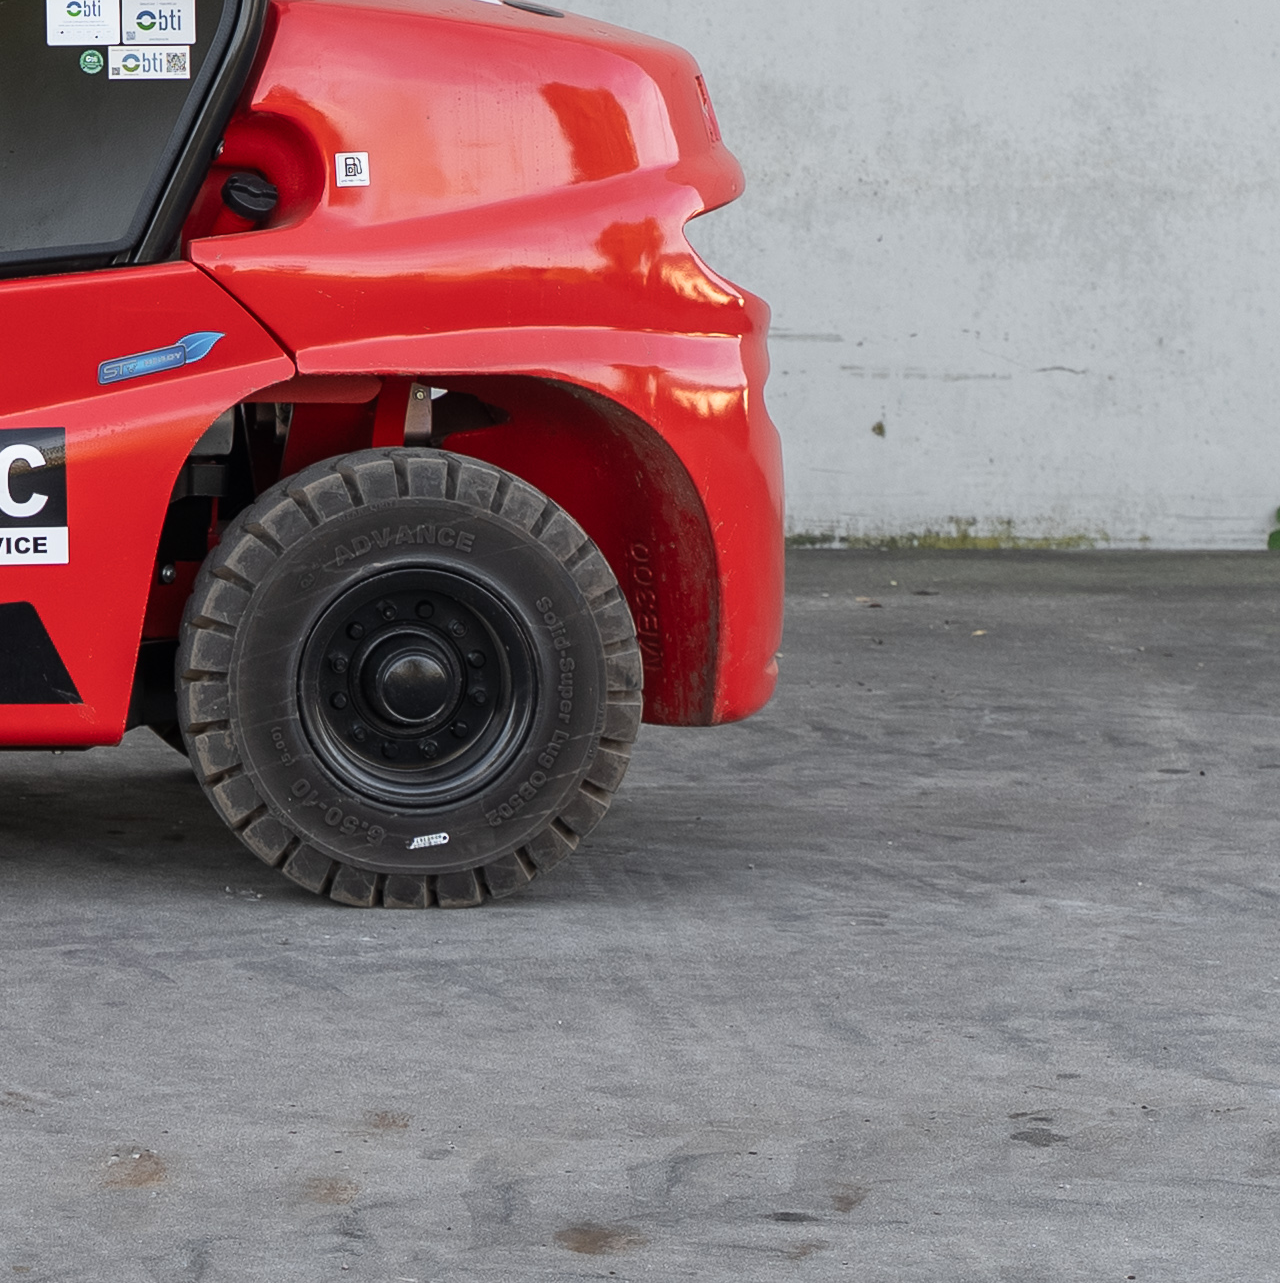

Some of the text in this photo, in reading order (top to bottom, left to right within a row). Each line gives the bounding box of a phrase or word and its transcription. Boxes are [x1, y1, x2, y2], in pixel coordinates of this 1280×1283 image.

[334, 523, 476, 567] ADVANCE
[484, 595, 576, 828] Solid-Super Lug OB502
[270, 726, 296, 766] (5.00)
[291, 778, 386, 846] 6.50-10
